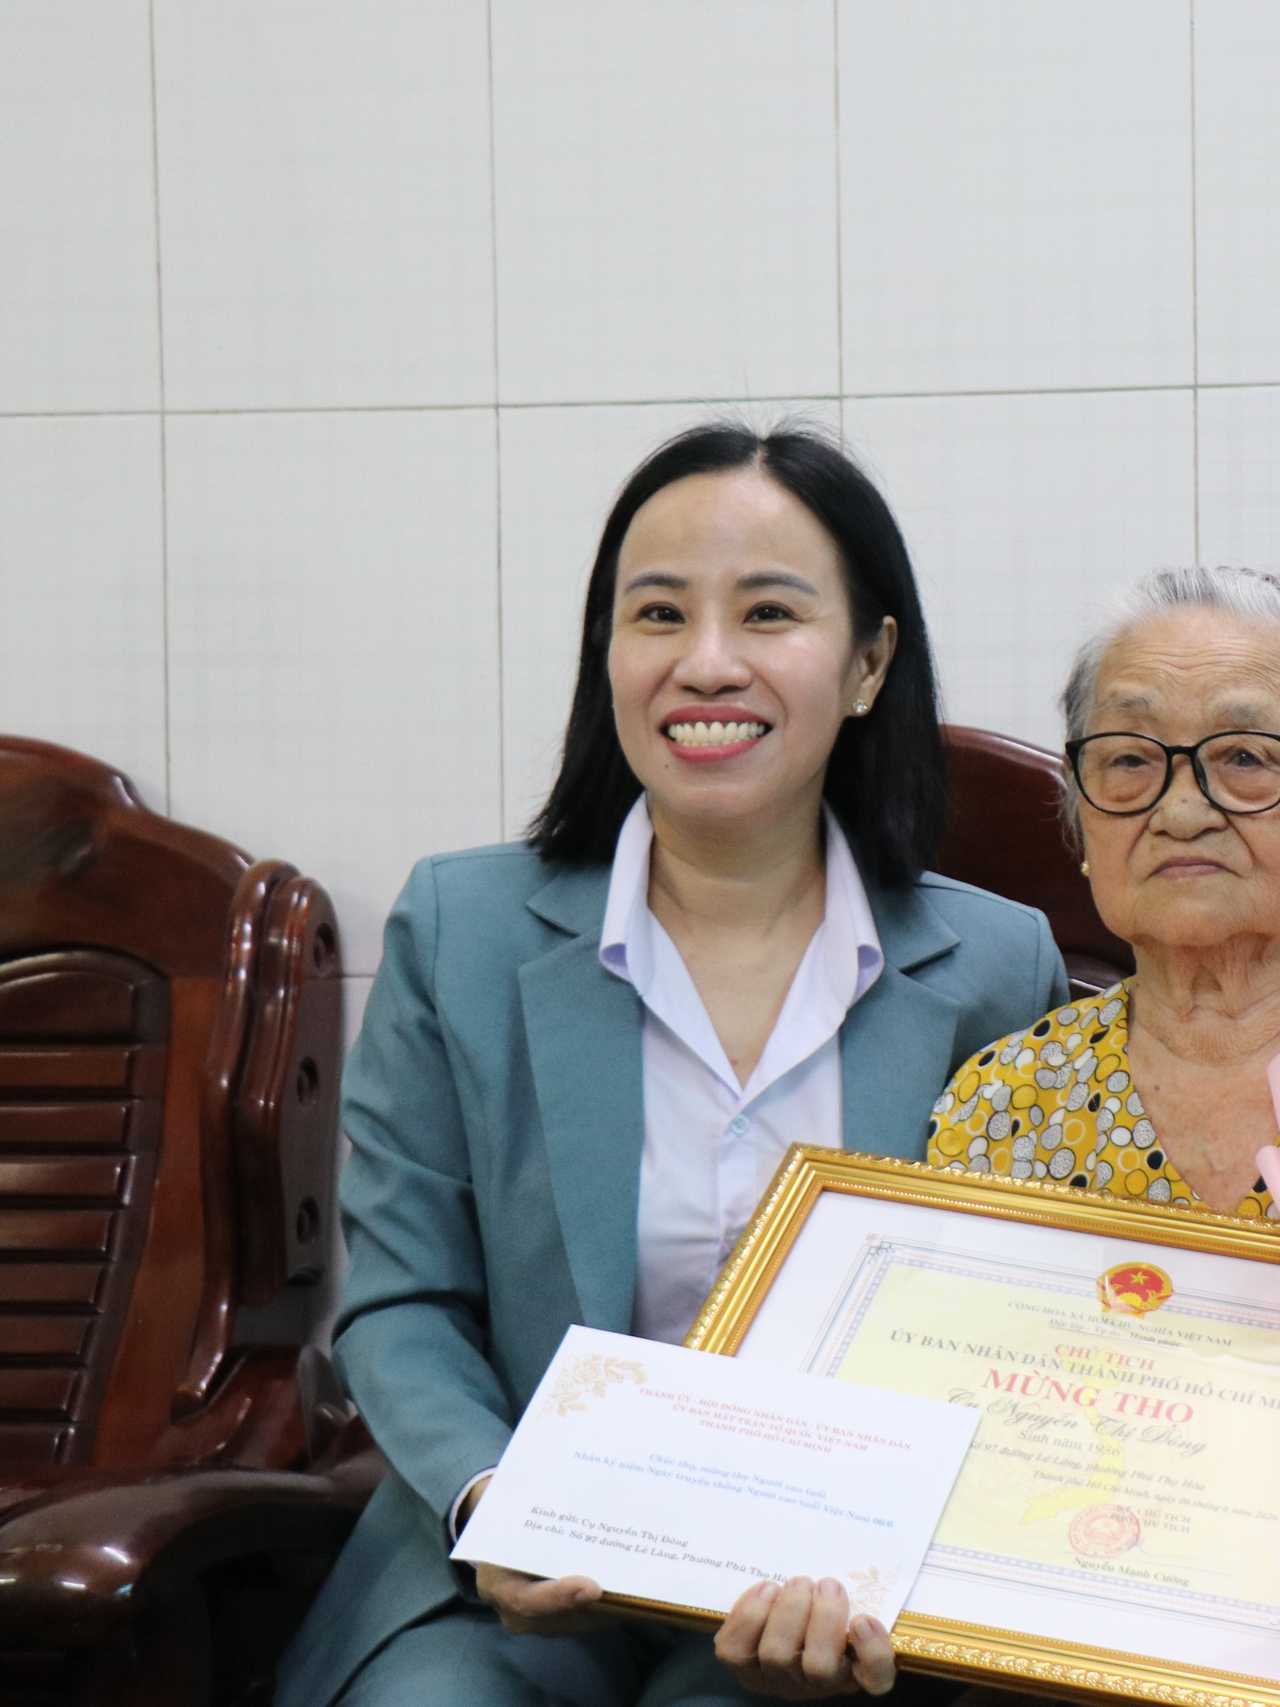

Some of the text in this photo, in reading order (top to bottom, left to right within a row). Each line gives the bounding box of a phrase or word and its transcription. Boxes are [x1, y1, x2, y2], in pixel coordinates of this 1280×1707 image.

[1206, 1335, 1232, 1346] NAM
[890, 1327, 917, 1344] ỦY
[920, 1335, 960, 1352] BAN
[963, 1342, 1018, 1362] NHÂN
[1022, 1353, 1063, 1370] DÂN
[1067, 1360, 1139, 1383] THÀNH
[1140, 1375, 1182, 1391] PHỐ
[1184, 1381, 1216, 1397] HỒ
[1218, 1389, 1256, 1405] CHÍ
[1055, 1343, 1156, 1370] CHỦ TỊCH
[981, 1368, 1195, 1428] MỪNG THỌ
[689, 1407, 711, 1417] BAN
[844, 1440, 869, 1451] NAM
[832, 1427, 855, 1438] BAN
[1017, 1429, 1120, 1457] Sinh năm 1936
[802, 1440, 832, 1453] MINH
[649, 1453, 676, 1465] Chúc
[785, 1483, 804, 1493] cao
[778, 1495, 797, 1505] cao
[846, 1509, 871, 1523] Nam
[581, 1517, 596, 1530] Cụ
[597, 1521, 639, 1538] Nguyễn
[641, 1529, 660, 1543] Thị
[584, 1533, 599, 1544] 97
[750, 1566, 771, 1580] Thọ
